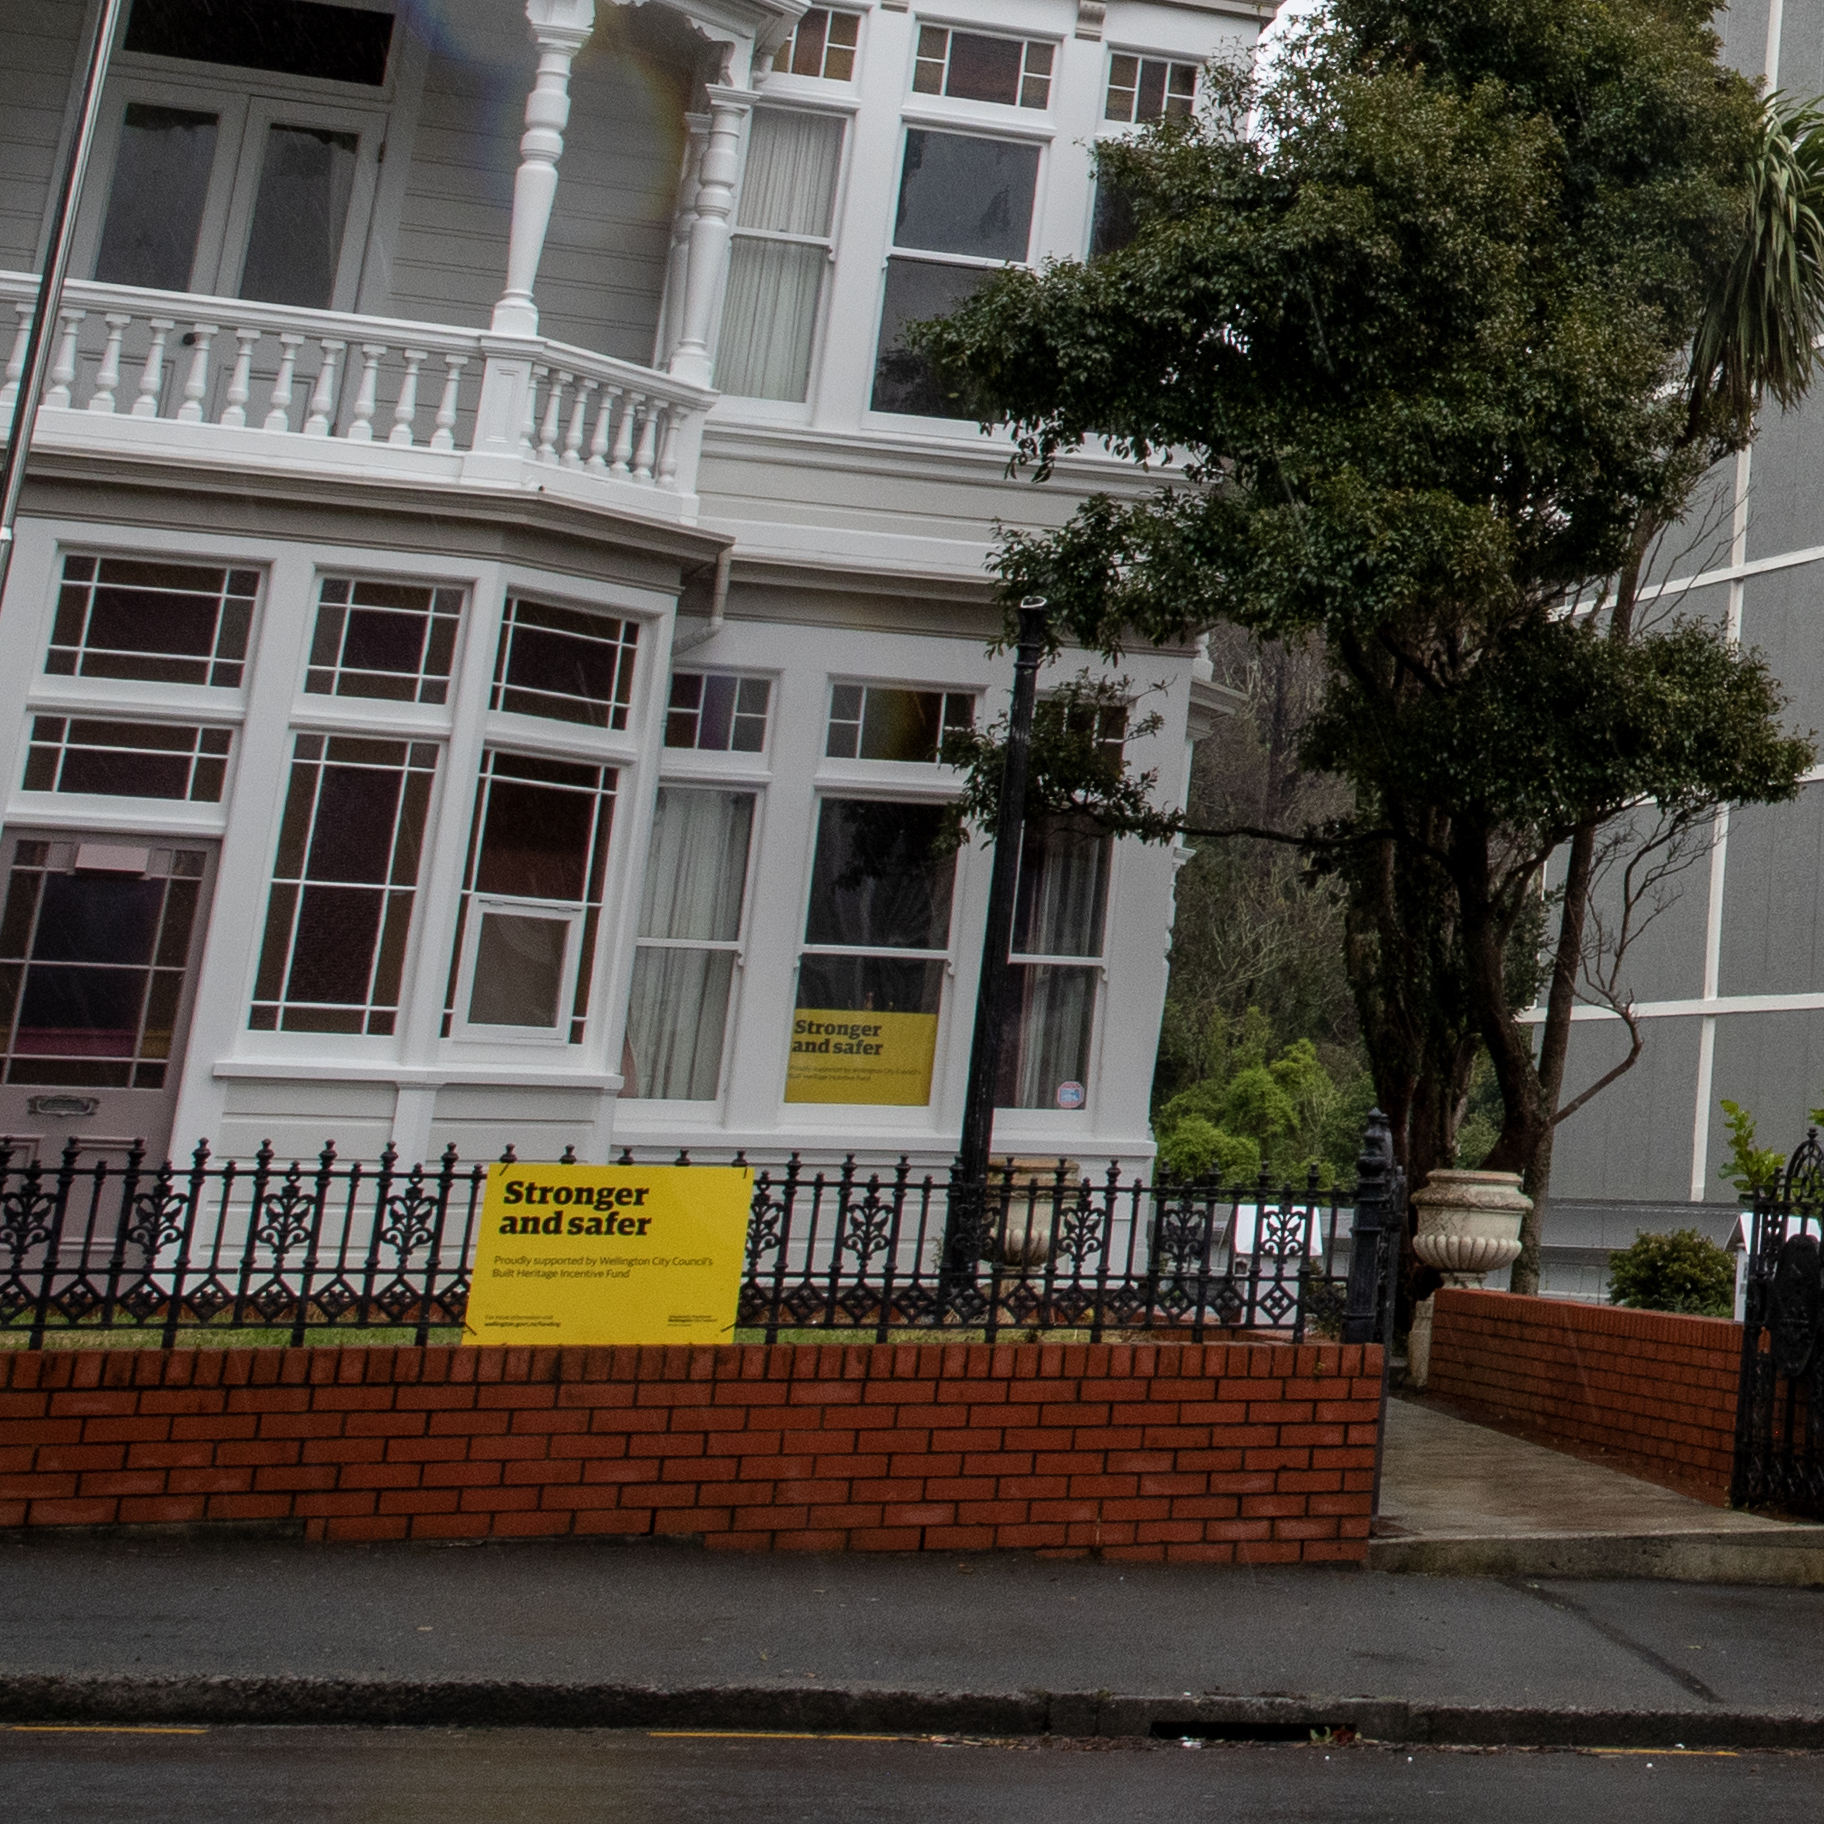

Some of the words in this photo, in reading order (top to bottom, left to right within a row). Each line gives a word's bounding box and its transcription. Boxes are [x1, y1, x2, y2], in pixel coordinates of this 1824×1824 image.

[794, 1019, 882, 1040] Stronger
[791, 1038, 831, 1054] and
[833, 1039, 883, 1055] safer
[503, 1180, 650, 1212] Stronger
[499, 1210, 564, 1235] and
[567, 1211, 652, 1236] safer
[494, 1255, 531, 1267] Proudly
[533, 1257, 584, 1267] supported
[585, 1257, 598, 1267] by
[599, 1257, 650, 1268] Wellington
[652, 1257, 671, 1267] City
[492, 1269, 514, 1277] Built
[516, 1269, 558, 1279] Heritage
[560, 1270, 605, 1278] Incentive
[606, 1269, 631, 1278] Fund
